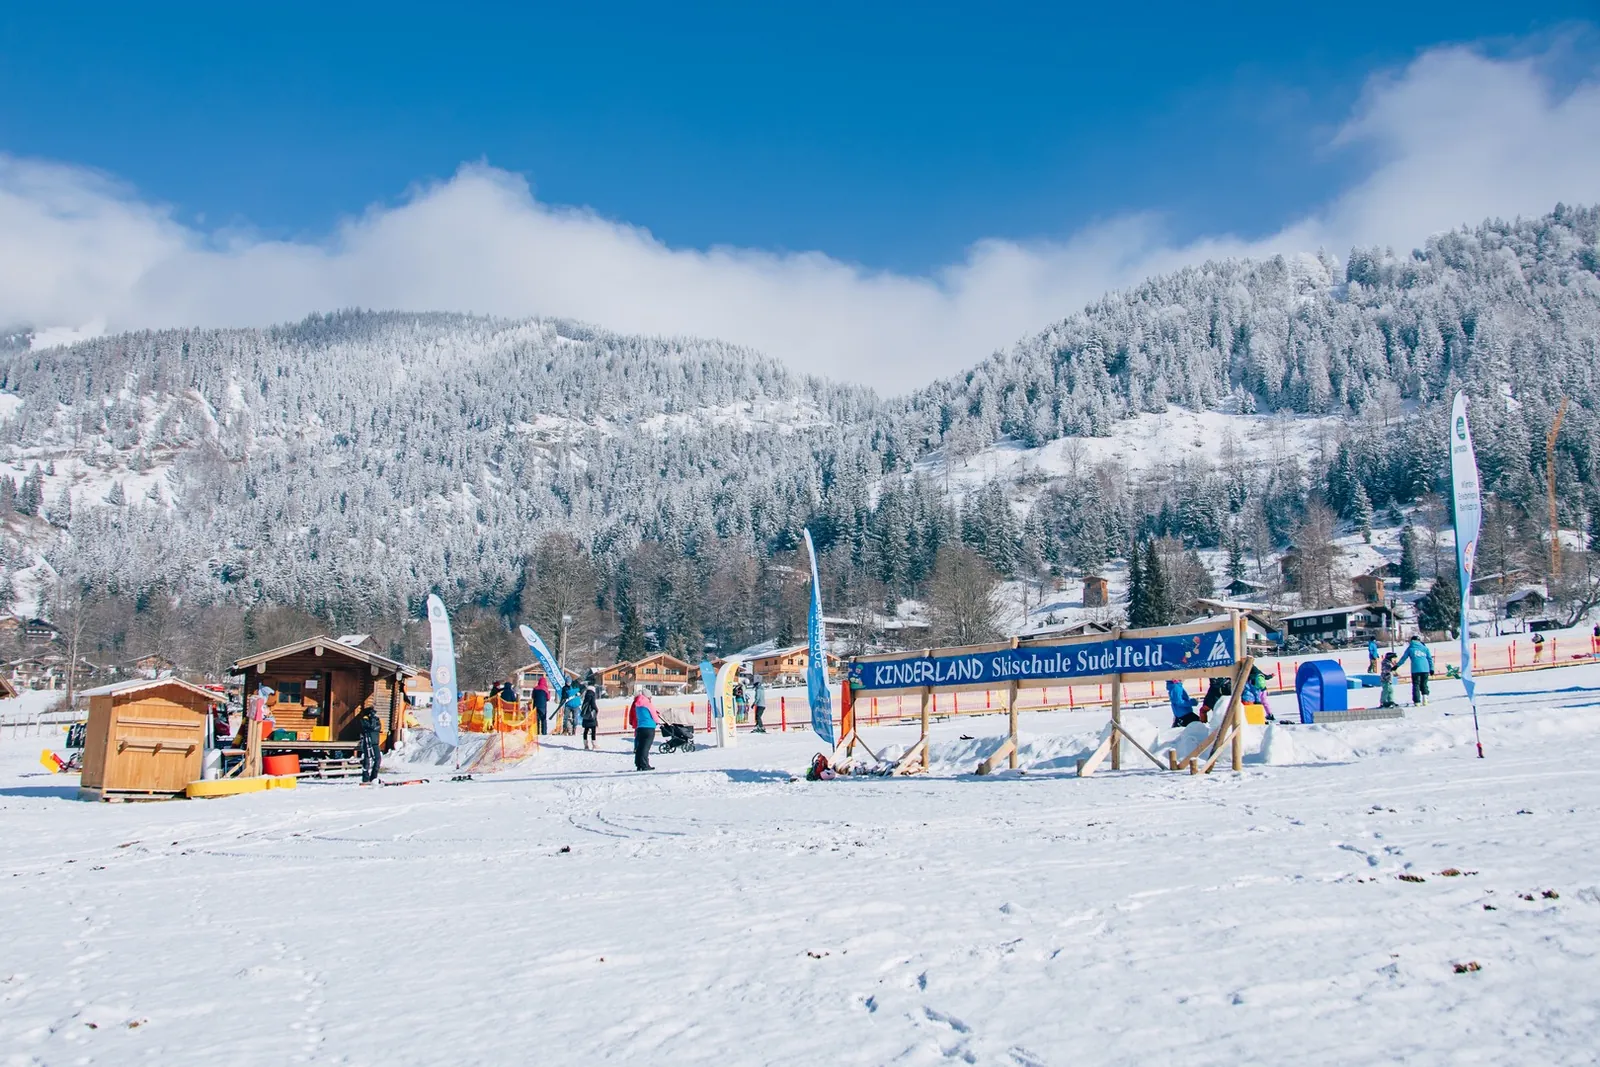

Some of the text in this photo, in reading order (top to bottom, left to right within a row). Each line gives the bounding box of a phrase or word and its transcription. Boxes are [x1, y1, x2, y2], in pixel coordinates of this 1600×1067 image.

[875, 645, 1163, 686] KINDERLAND Skischule Sudelfeld
